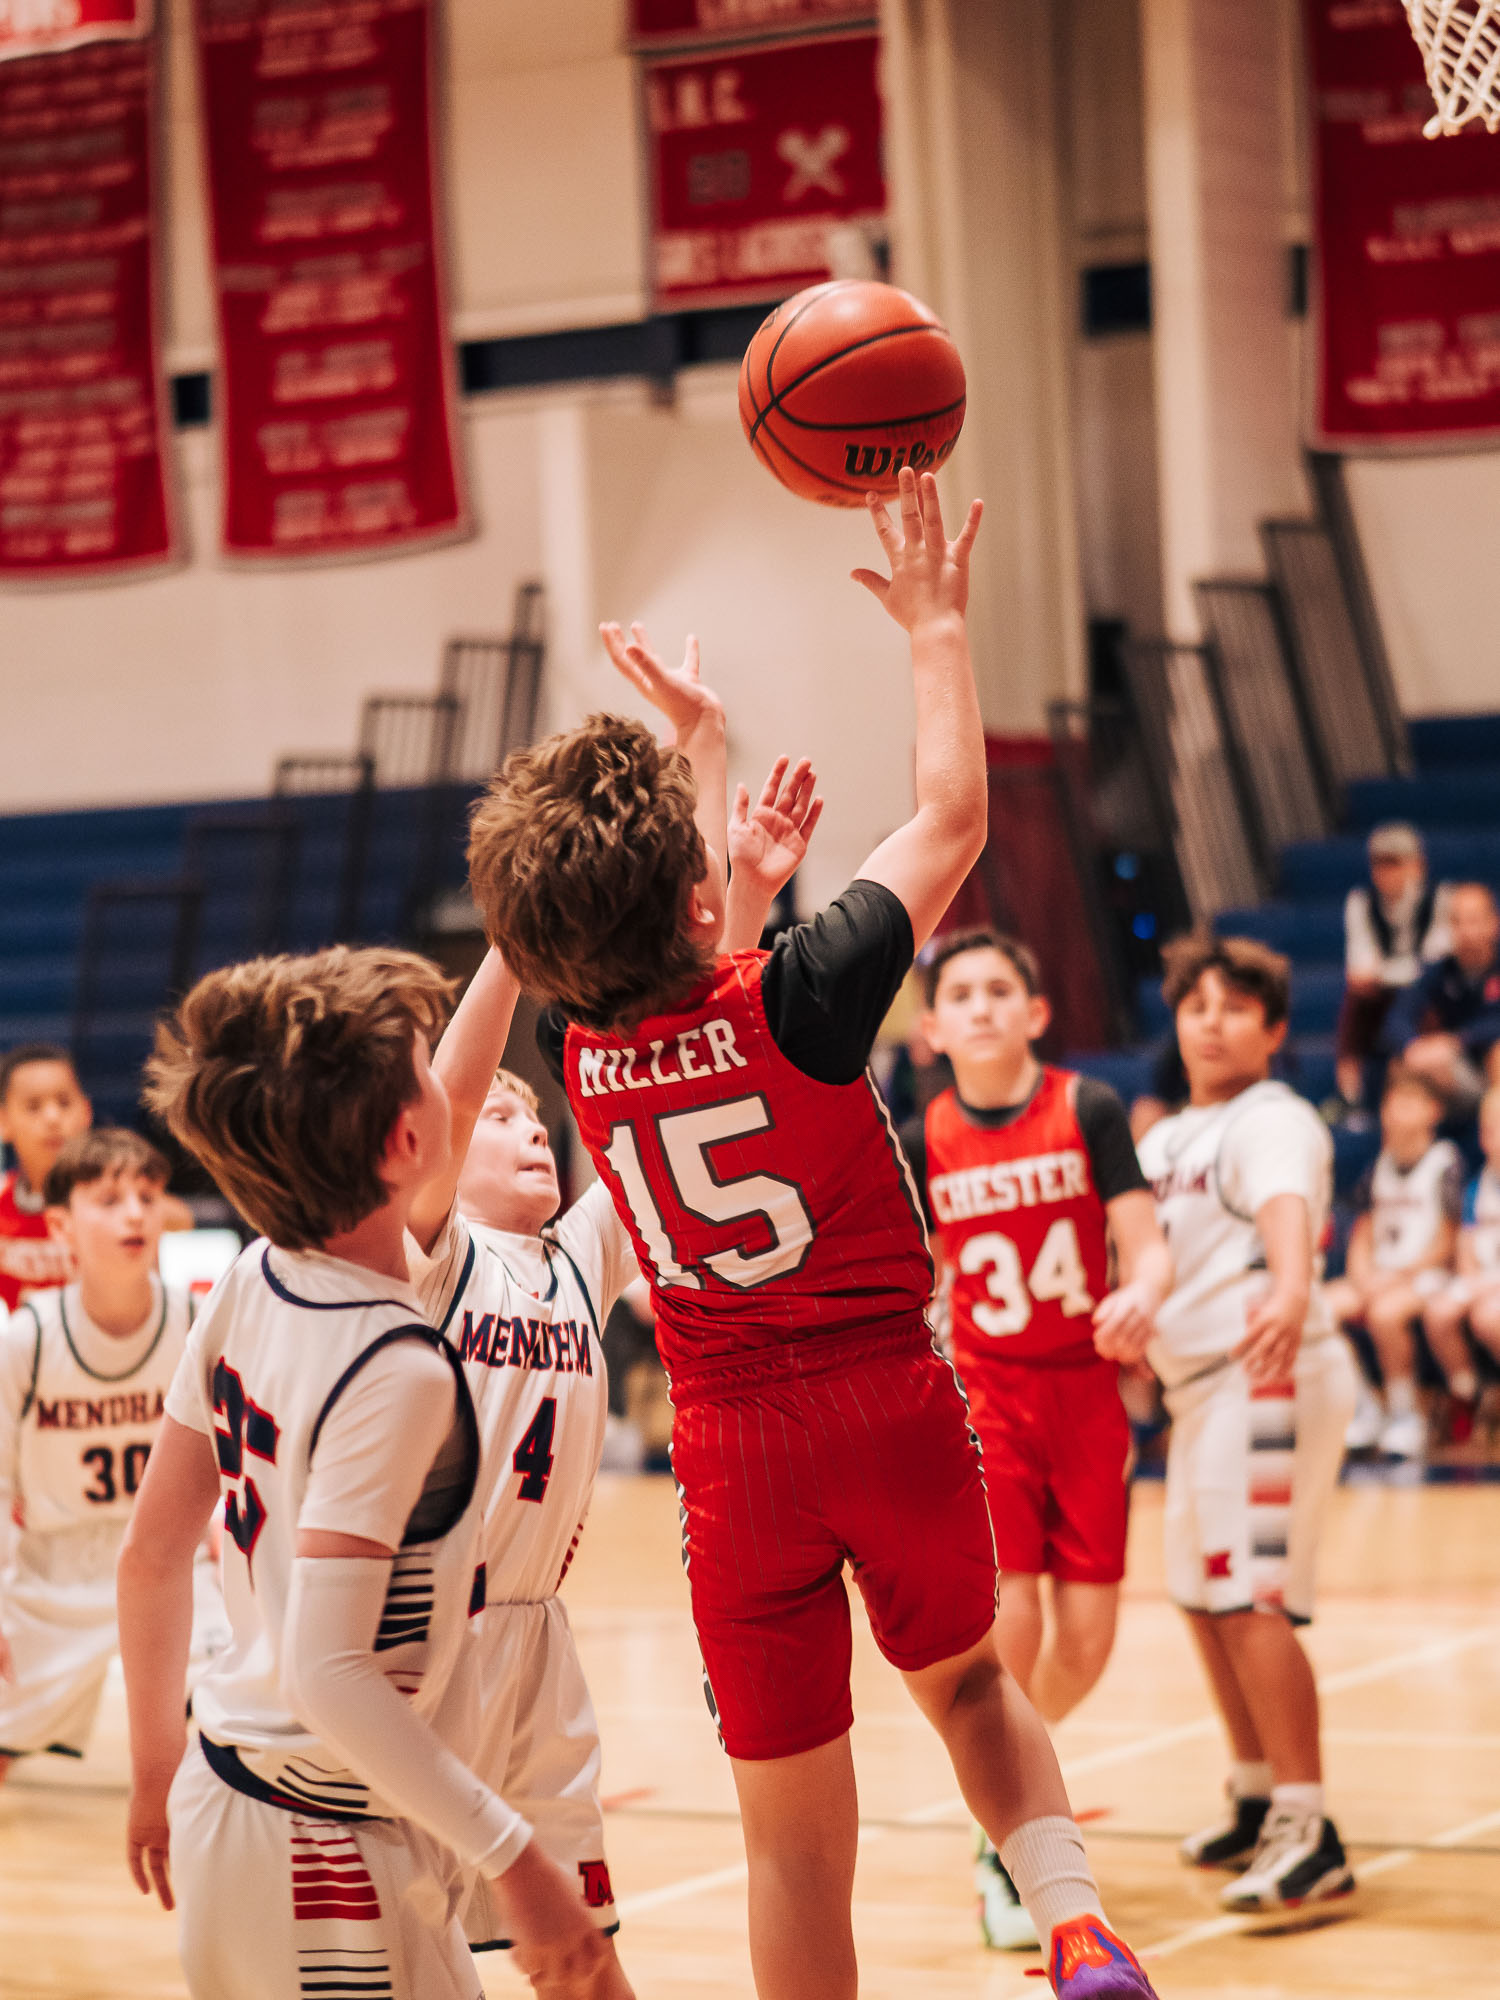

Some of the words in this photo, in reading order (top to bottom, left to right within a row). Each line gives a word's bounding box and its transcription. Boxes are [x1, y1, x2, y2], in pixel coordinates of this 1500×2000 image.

[844, 438, 956, 477] Wilso
[579, 1018, 747, 1097] MILLER
[600, 1090, 817, 1291] 15
[930, 1149, 1088, 1224] CHESTER
[959, 1217, 1095, 1337] 34
[37, 1389, 164, 1430] MENDHA
[82, 1440, 153, 1503] 30
[513, 1396, 557, 1503] 4
[577, 1859, 615, 1908] M
